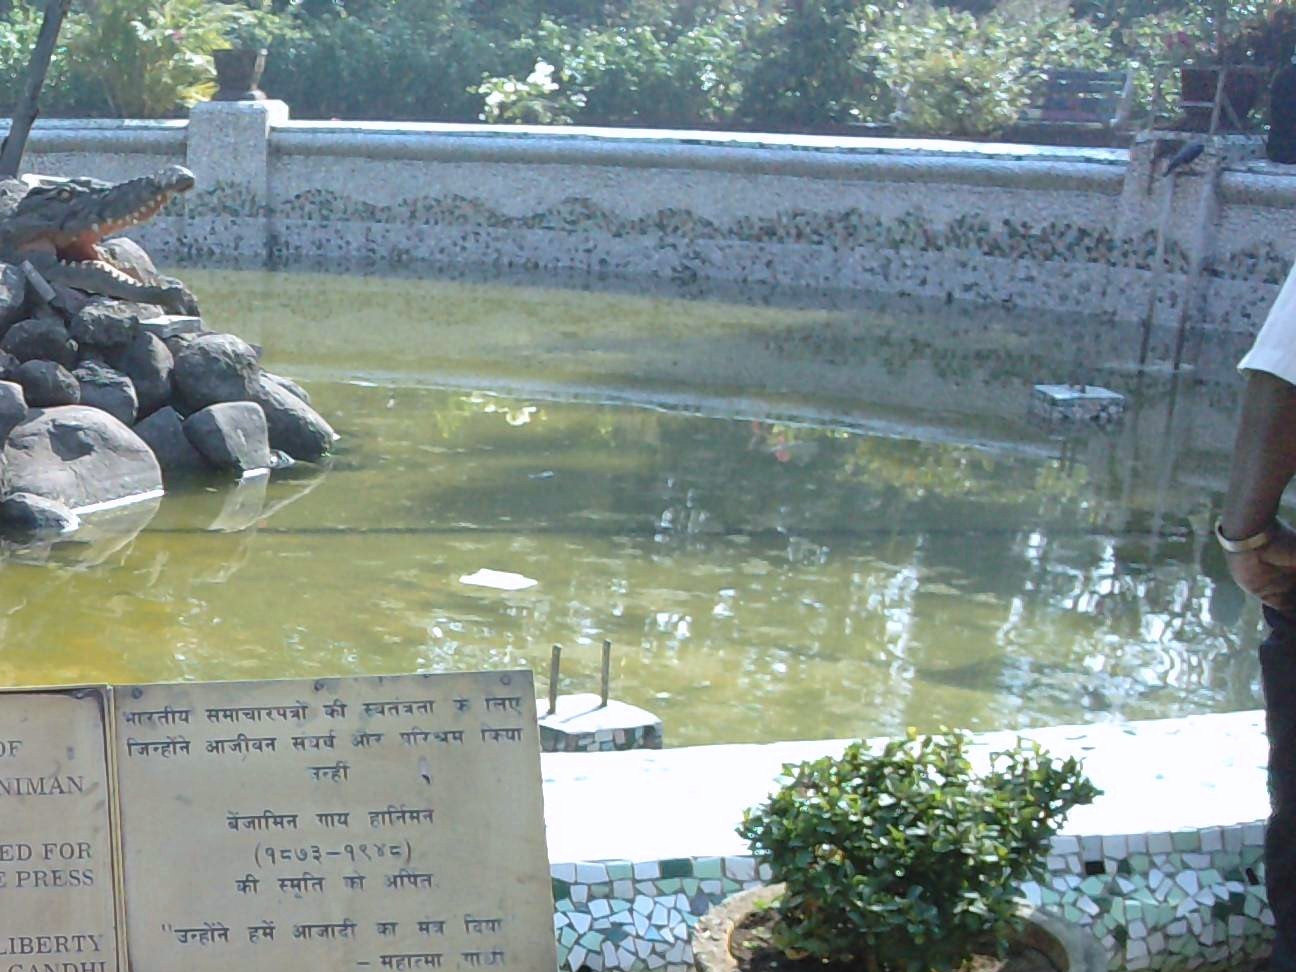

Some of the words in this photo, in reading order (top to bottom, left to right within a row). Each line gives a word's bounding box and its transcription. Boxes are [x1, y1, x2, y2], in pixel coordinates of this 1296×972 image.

[324, 699, 347, 719] की
[485, 695, 522, 714] लिए
[205, 733, 277, 754] आजीवन
[481, 723, 523, 742] किया
[316, 812, 349, 828] गाय
[42, 842, 93, 861] FOR
[15, 868, 95, 888] PRESS
[235, 873, 260, 894] की
[248, 920, 275, 943] हमें
[376, 921, 398, 937] का
[379, 953, 442, 971] महात्मा
